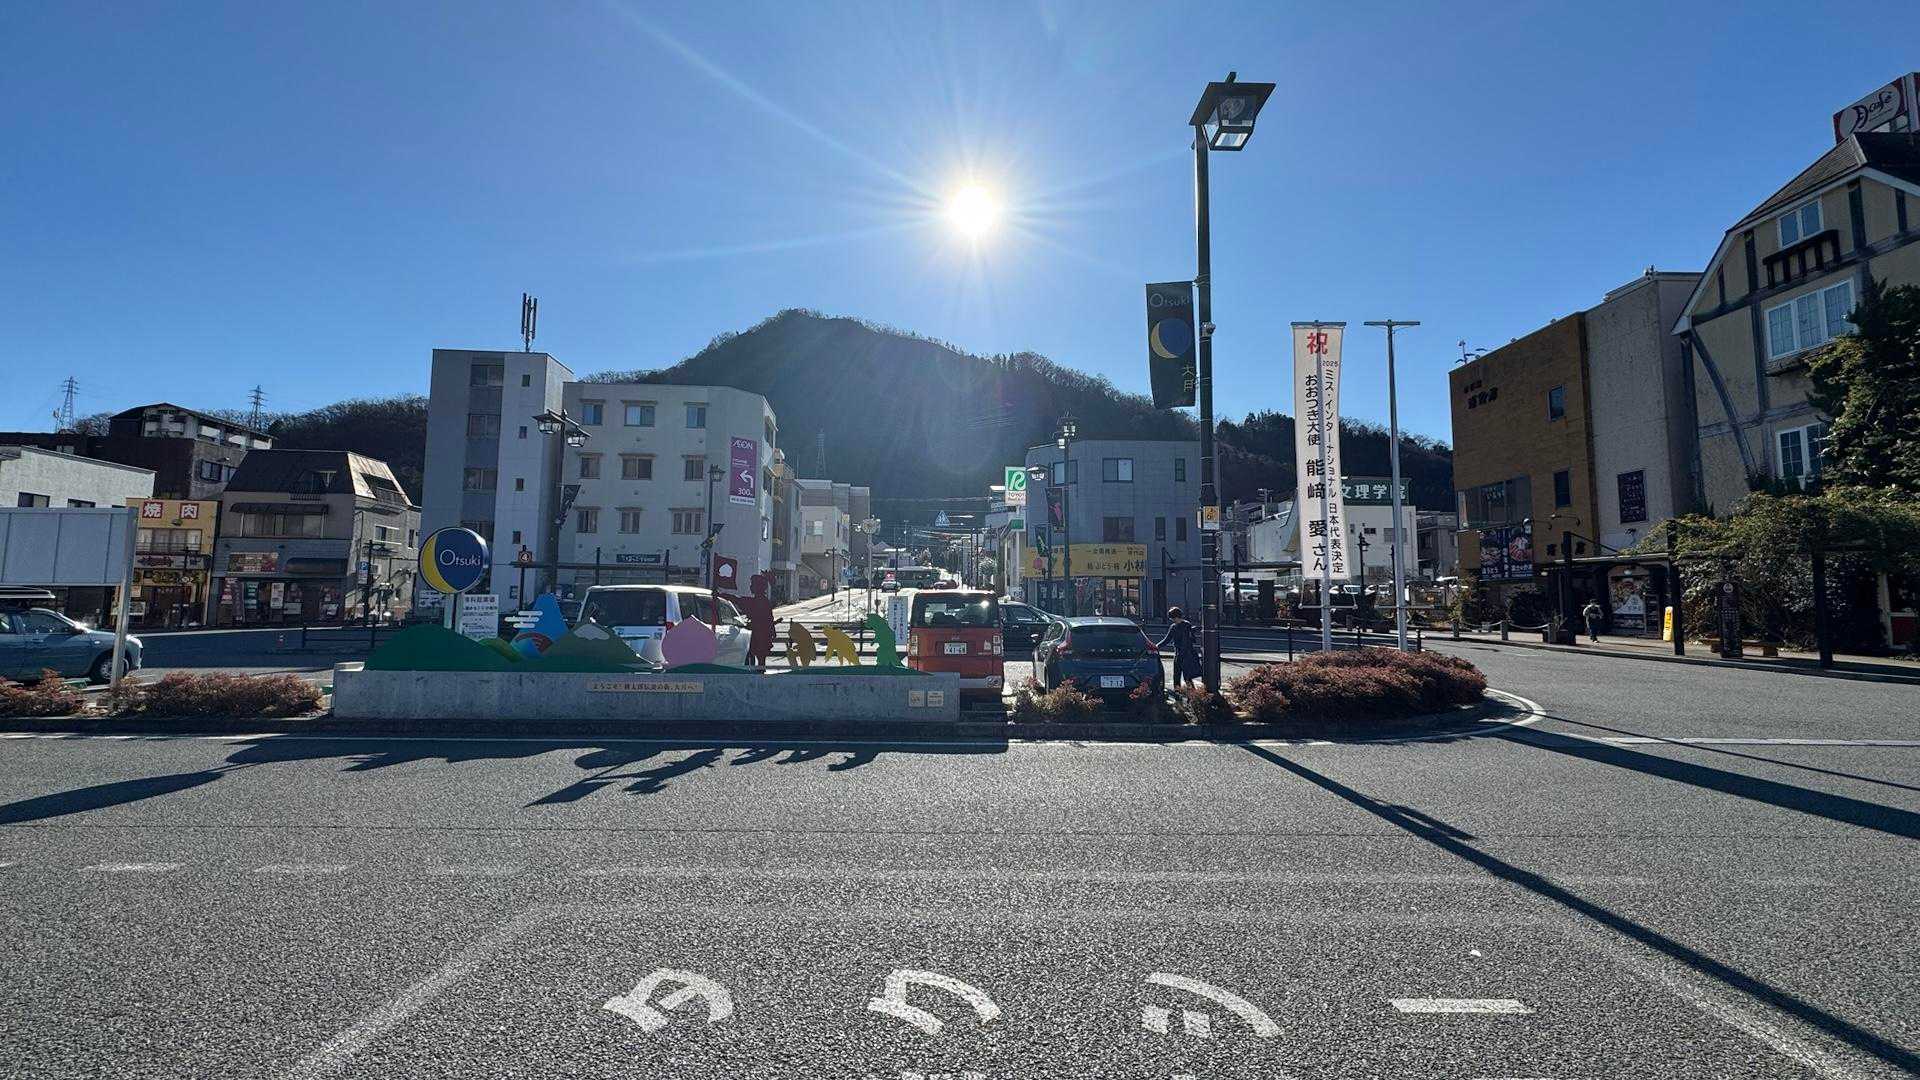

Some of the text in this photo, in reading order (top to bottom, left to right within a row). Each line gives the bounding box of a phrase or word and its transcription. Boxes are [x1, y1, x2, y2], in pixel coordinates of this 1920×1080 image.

[1150, 294, 1190, 307] Otsuki
[1307, 332, 1328, 355] 祝
[143, 501, 199, 519] 焼肉
[440, 549, 480, 566] Otsuki
